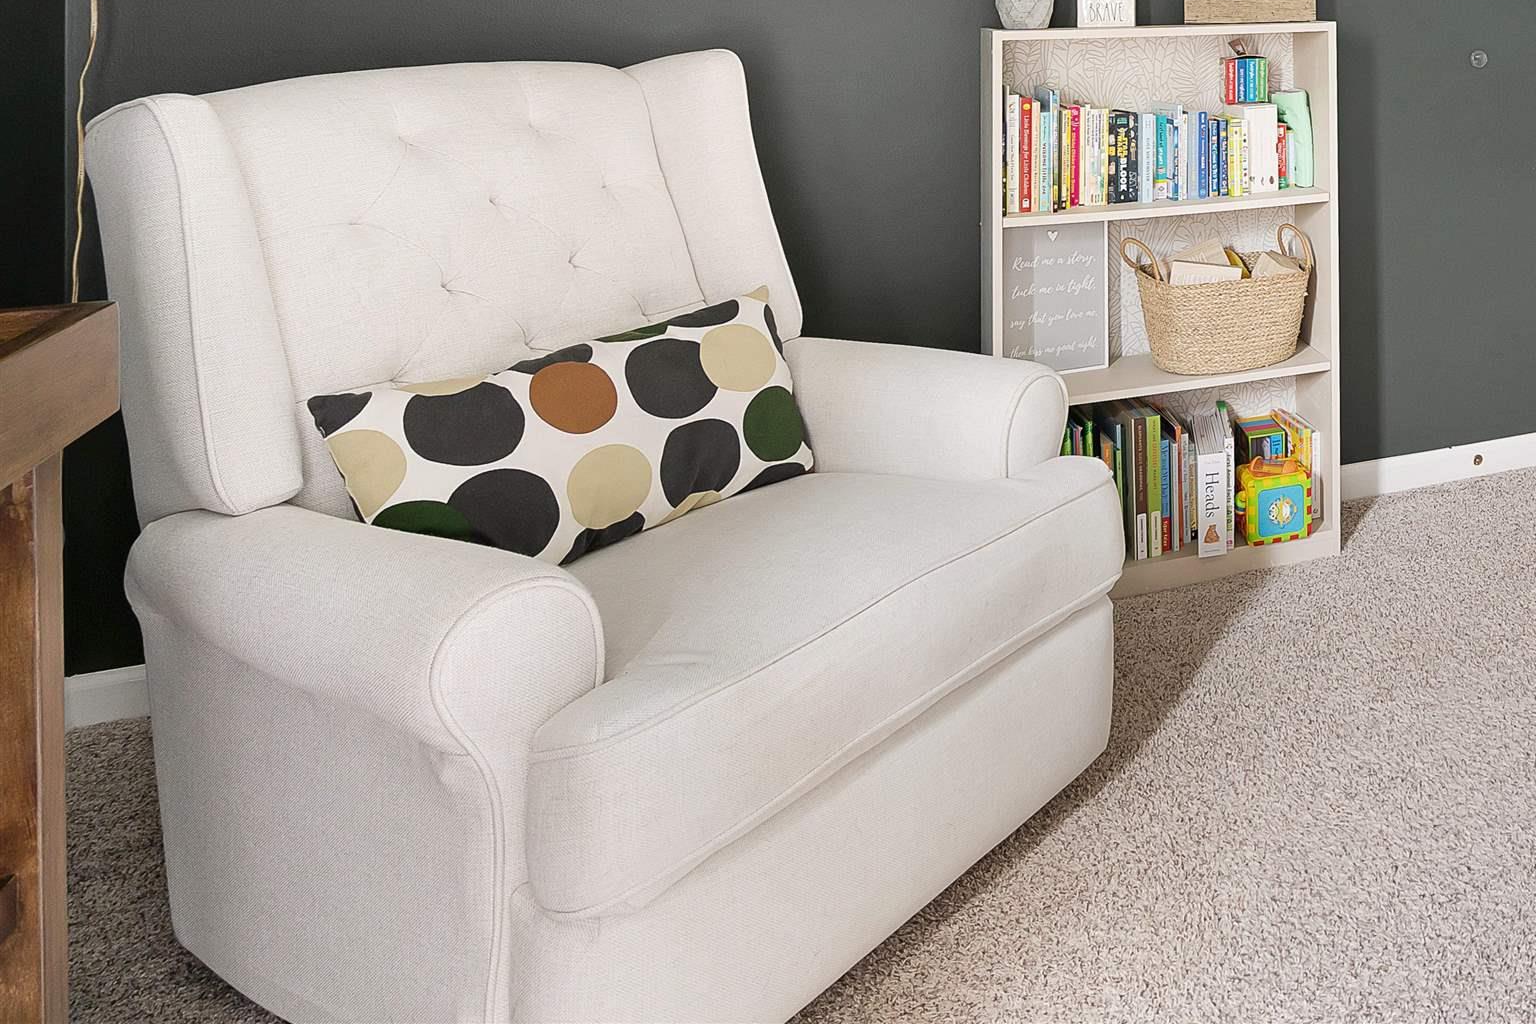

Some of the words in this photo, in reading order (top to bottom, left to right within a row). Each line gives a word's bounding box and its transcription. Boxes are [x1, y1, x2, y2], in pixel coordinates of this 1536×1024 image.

[1089, 2, 1129, 22] BRAVE
[1012, 256, 1040, 272] Read
[1042, 256, 1056, 266] me
[1039, 286, 1054, 295] me
[1027, 310, 1047, 326] that
[1066, 307, 1084, 321] love
[1205, 472, 1221, 519] Heads
